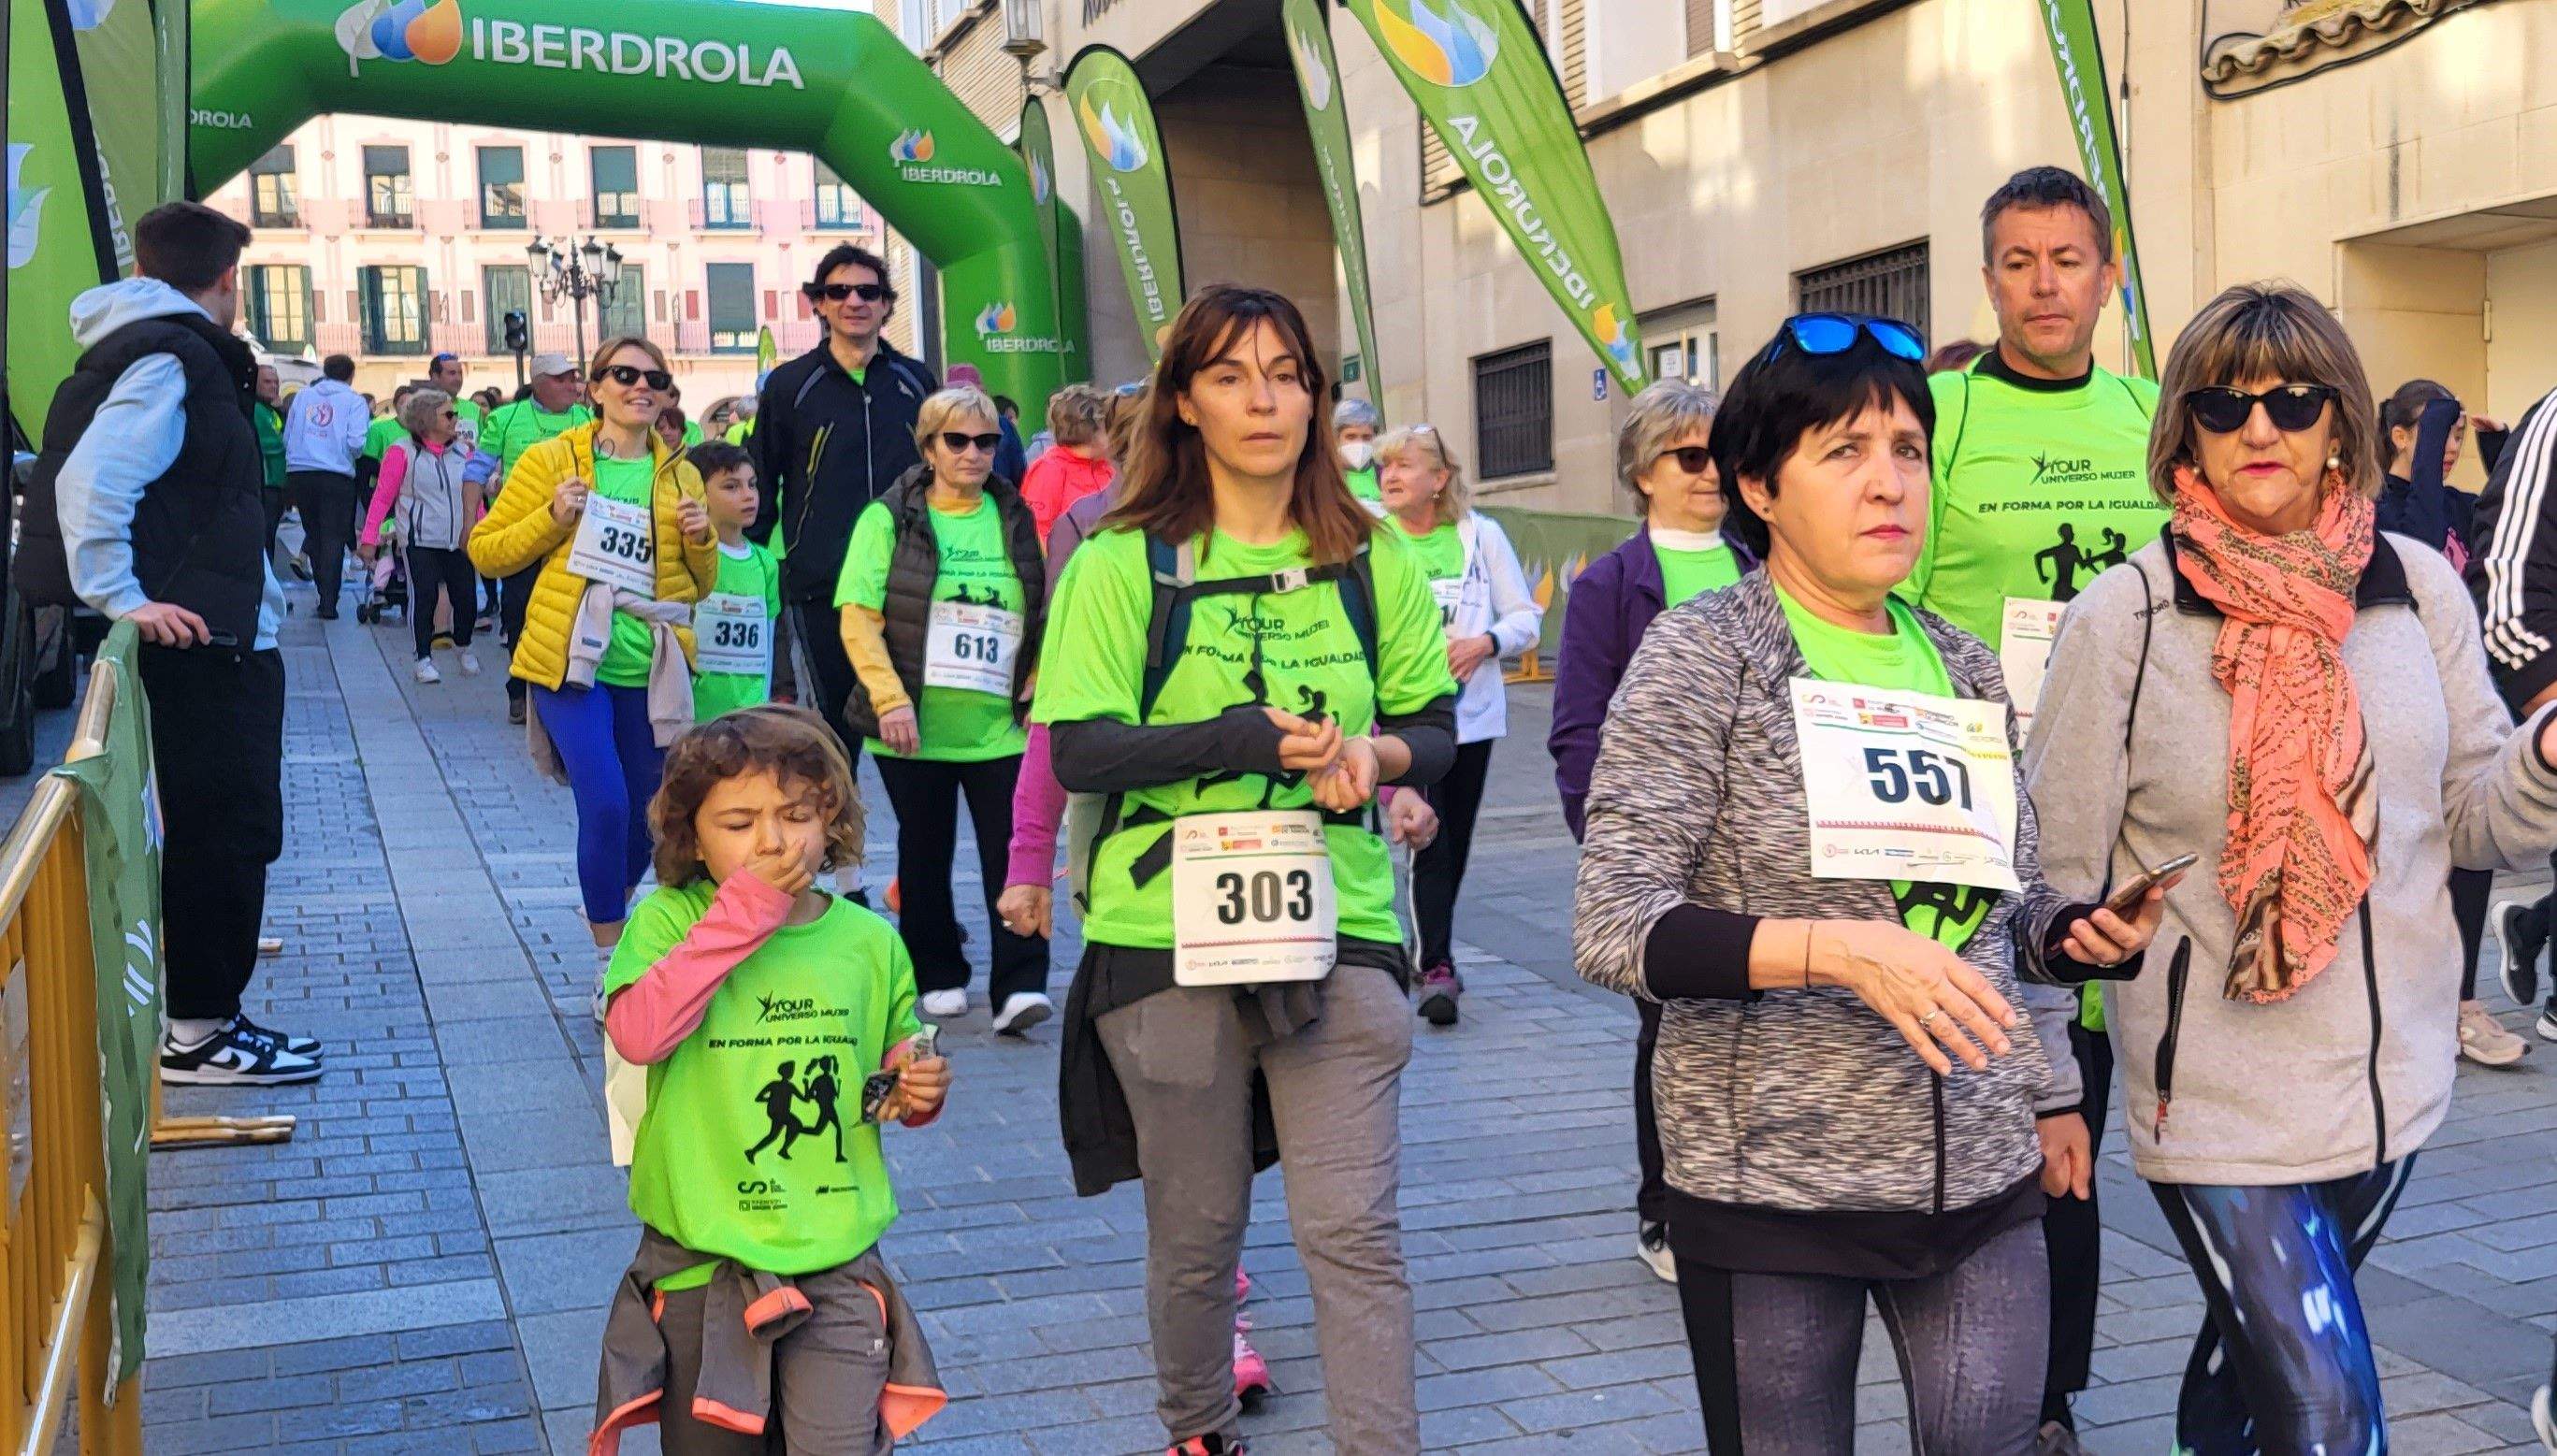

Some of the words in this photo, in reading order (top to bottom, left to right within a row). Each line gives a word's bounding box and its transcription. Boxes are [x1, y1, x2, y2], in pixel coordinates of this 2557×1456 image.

[472, 17, 804, 89] IBERDROLA
[902, 166, 1003, 186] IBERDROLA
[2041, 471, 2098, 484] UNIVERSO
[2100, 470, 2136, 481] MUJER
[1978, 503, 1998, 513] EN
[2001, 500, 2052, 512] FORMA
[2056, 499, 2085, 511] POR
[2088, 499, 2105, 511] LA
[600, 526, 652, 563] 335
[715, 620, 759, 649] 336
[954, 633, 999, 664] 613
[1281, 657, 1301, 670] LA
[1863, 747, 1973, 812] 557
[1216, 869, 1313, 925] 303
[765, 1010, 818, 1023] UNIVERSO
[708, 1038, 727, 1049] EN
[729, 1036, 773, 1048] FORMA
[777, 1036, 802, 1046] POR
[805, 1035, 820, 1045] LA
